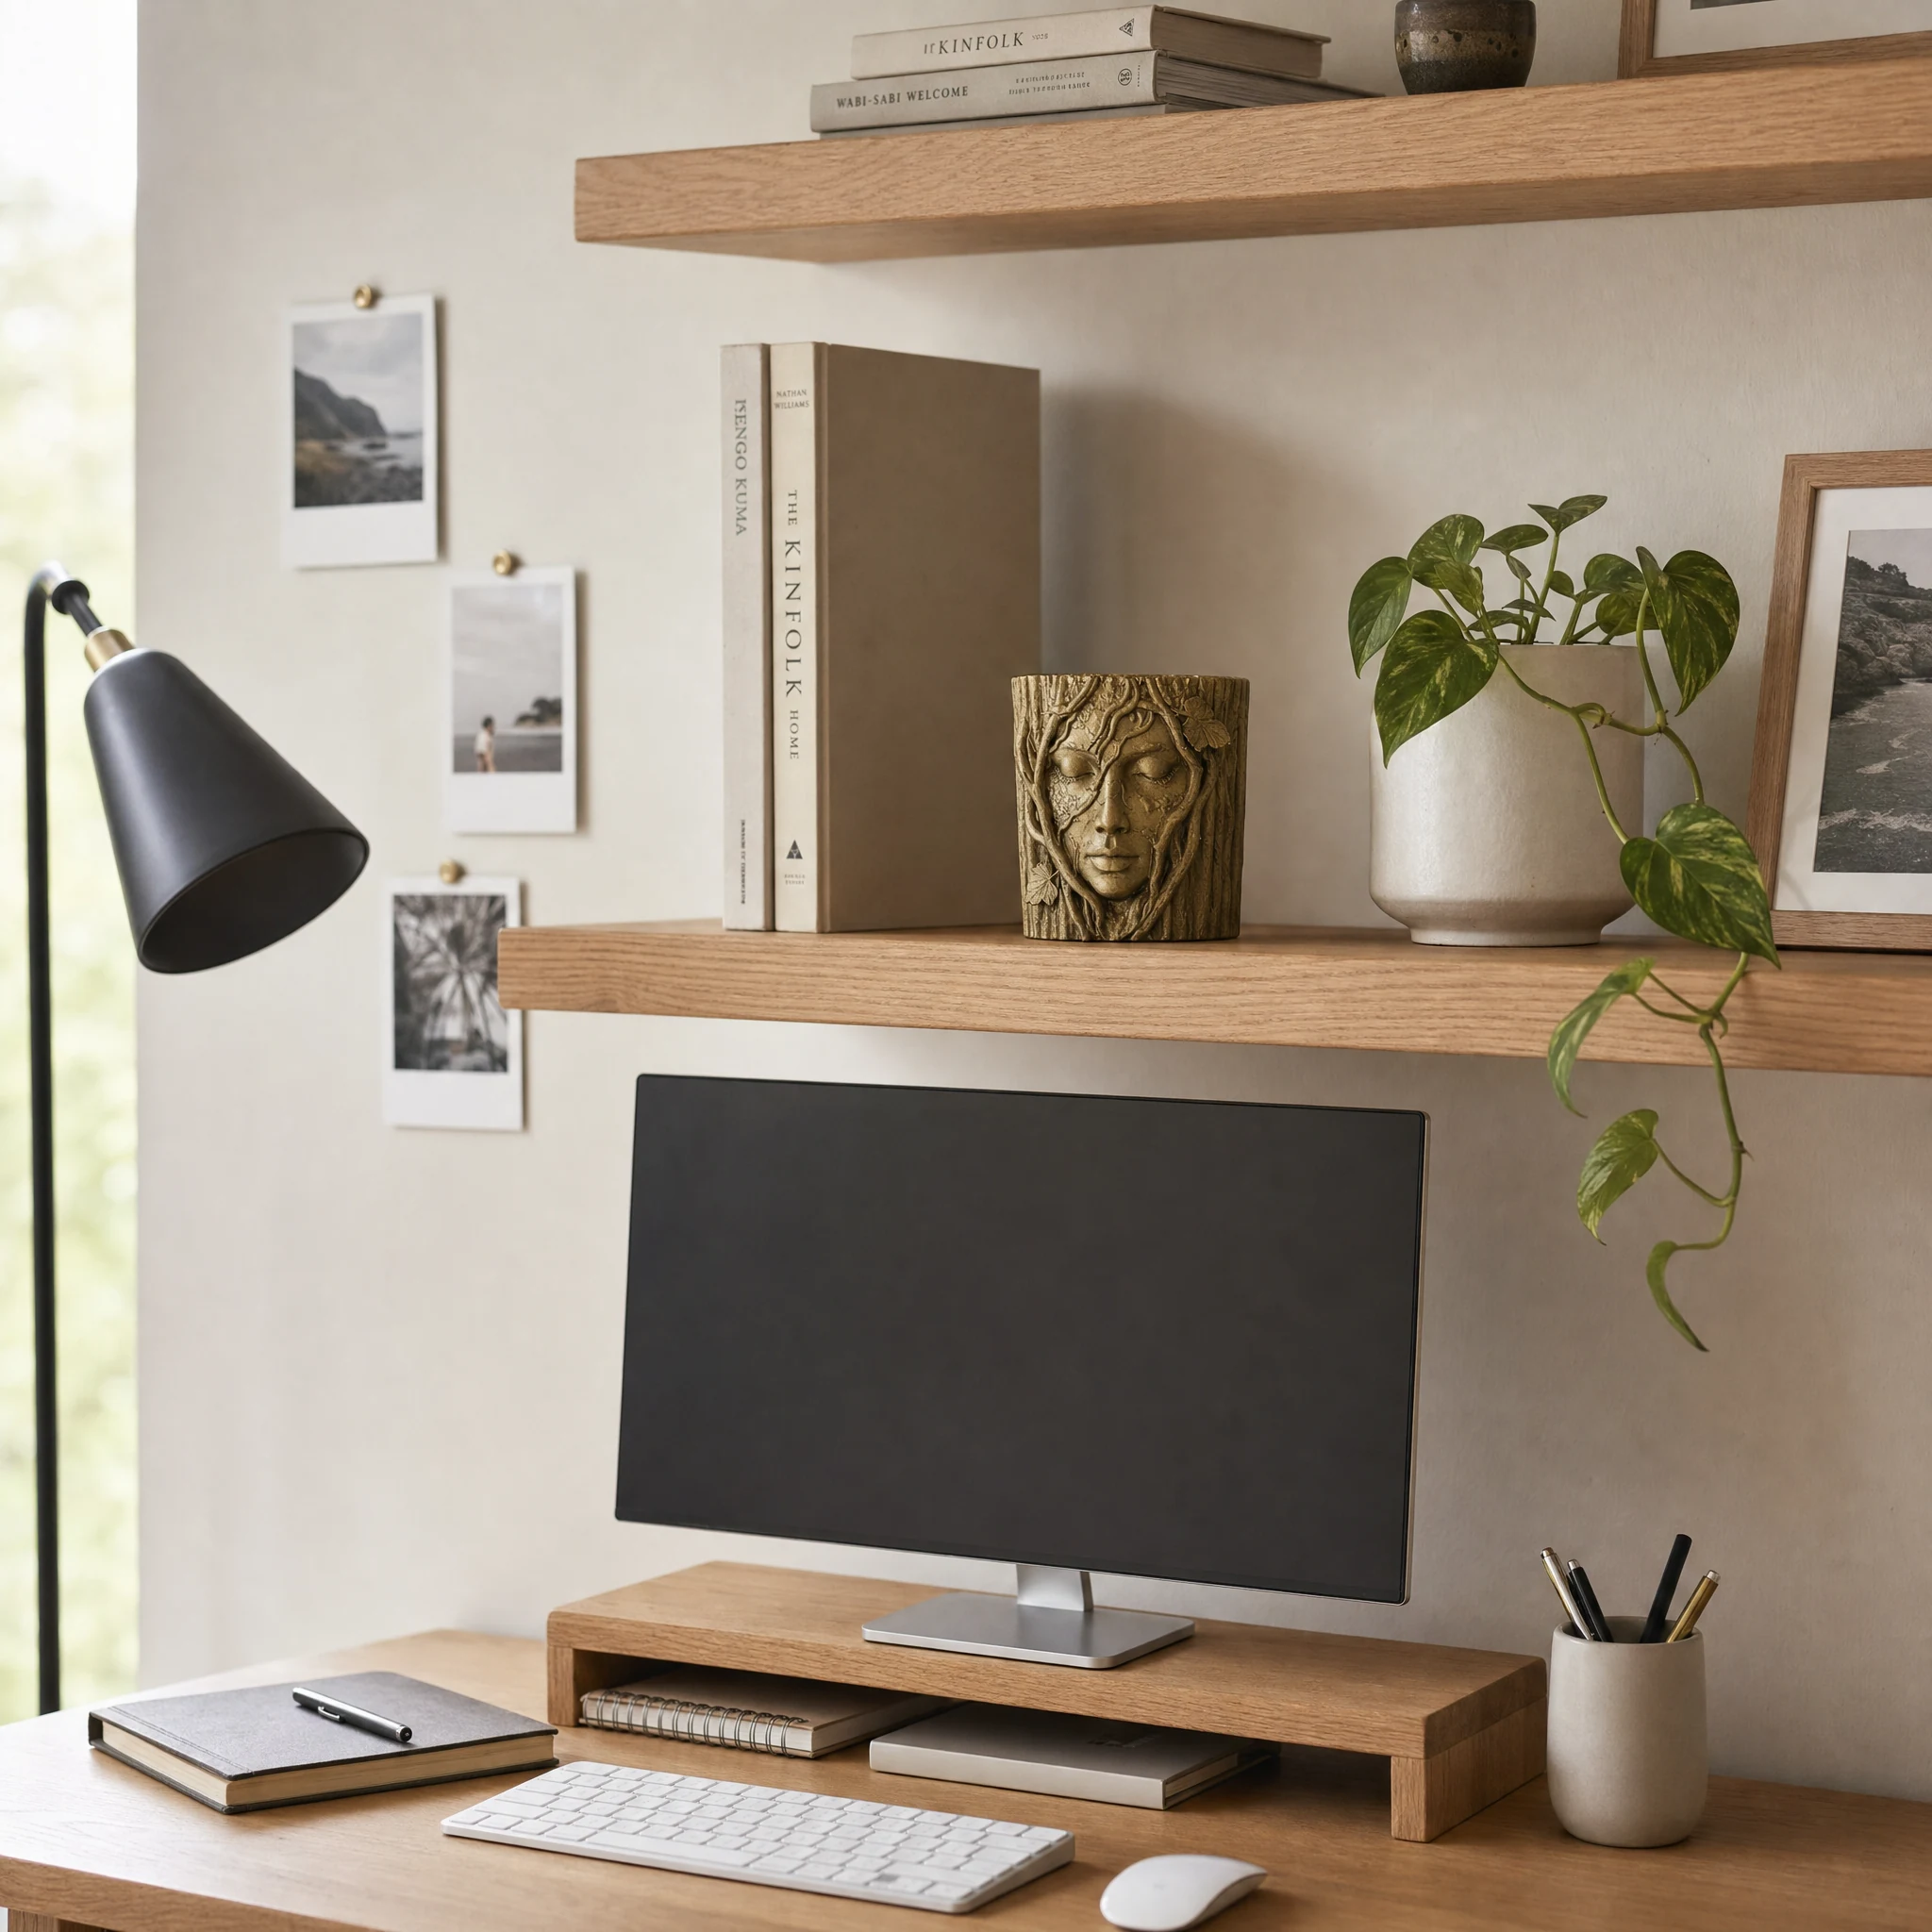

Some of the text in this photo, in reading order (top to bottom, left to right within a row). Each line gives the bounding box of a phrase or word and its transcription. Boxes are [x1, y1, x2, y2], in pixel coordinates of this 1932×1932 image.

[837, 86, 969, 108] WABI-SABI WELCOME
[776, 389, 808, 397] NATHAN
[774, 400, 809, 409] WILLIAMS
[735, 478, 747, 536] KUMA
[785, 490, 802, 759] THE KINFOLK HOME
